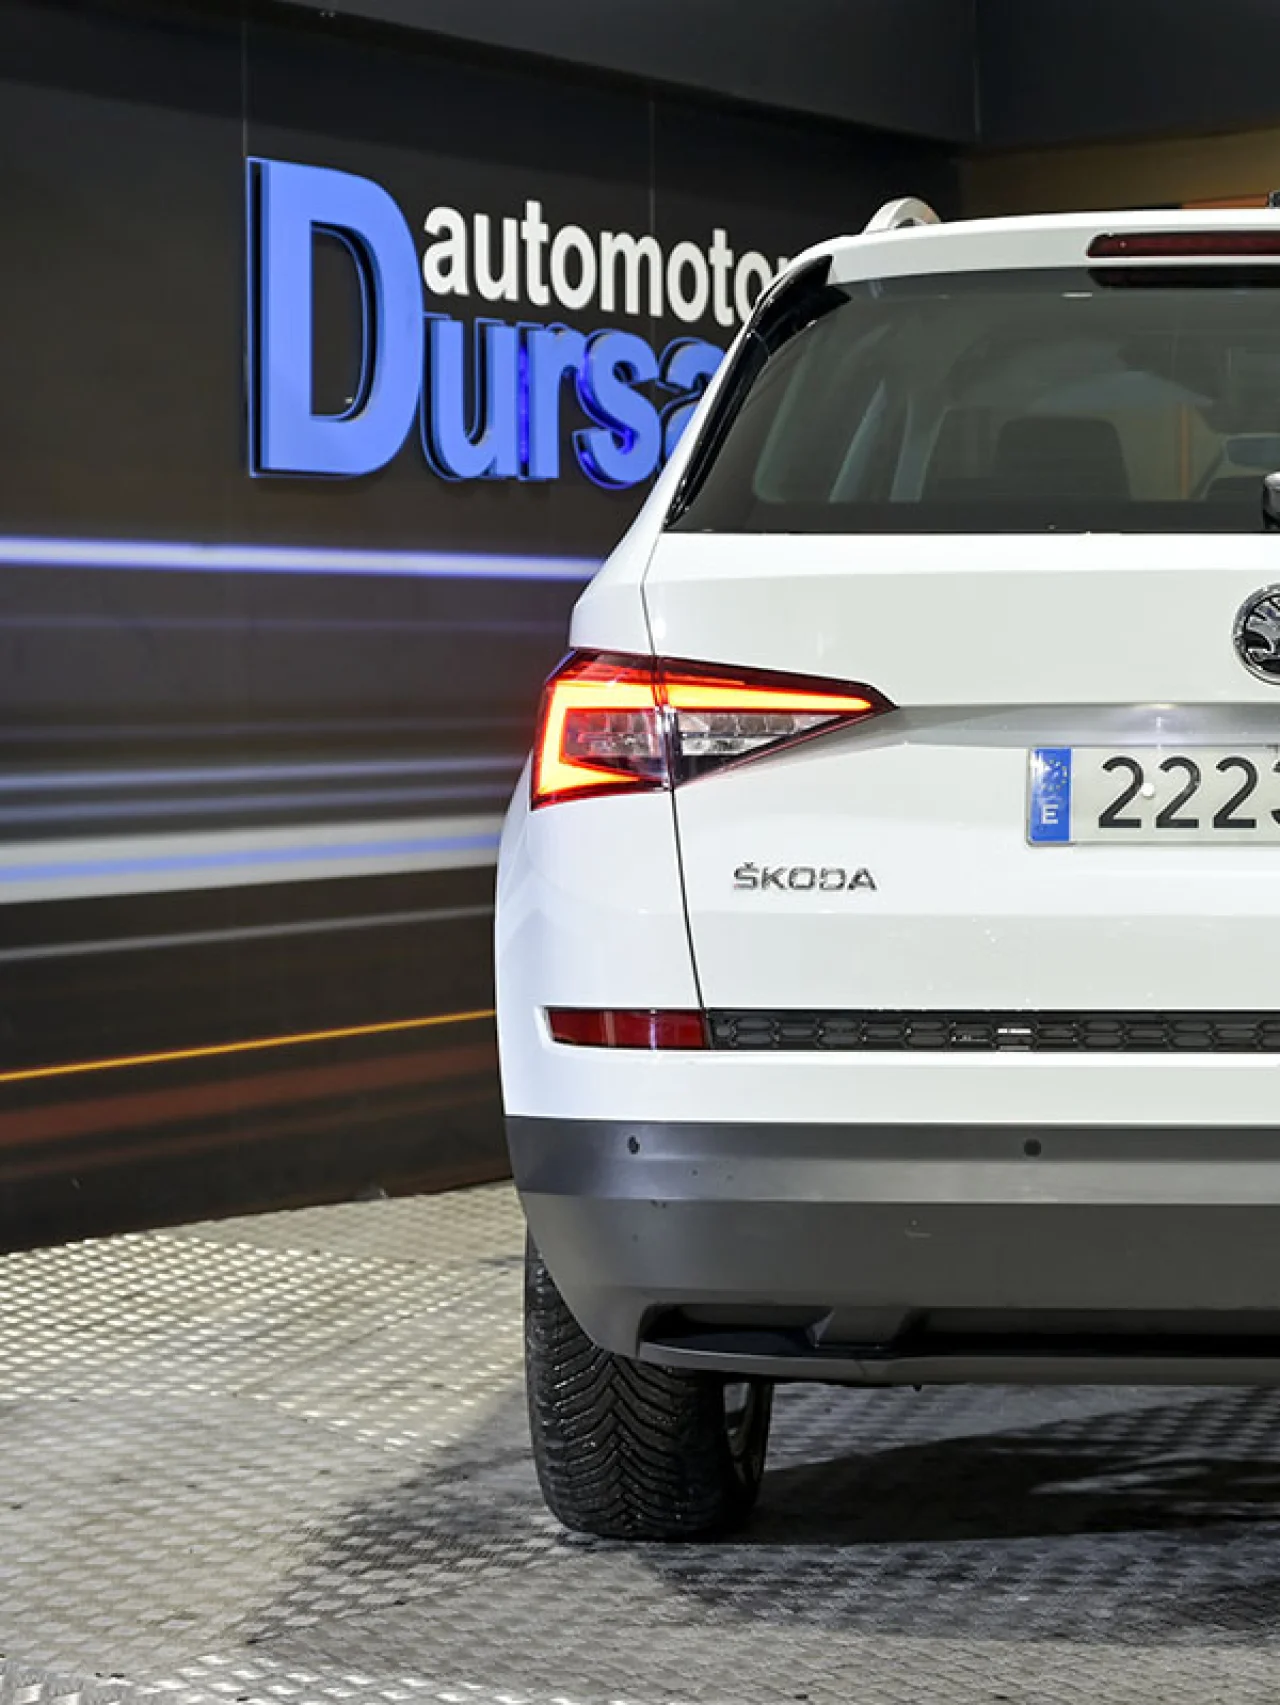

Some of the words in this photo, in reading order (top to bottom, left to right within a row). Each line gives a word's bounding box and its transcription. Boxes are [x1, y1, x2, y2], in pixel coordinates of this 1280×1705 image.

[423, 200, 793, 328] automoto
[1041, 803, 1059, 825] E
[733, 861, 878, 892] ŠKODA
